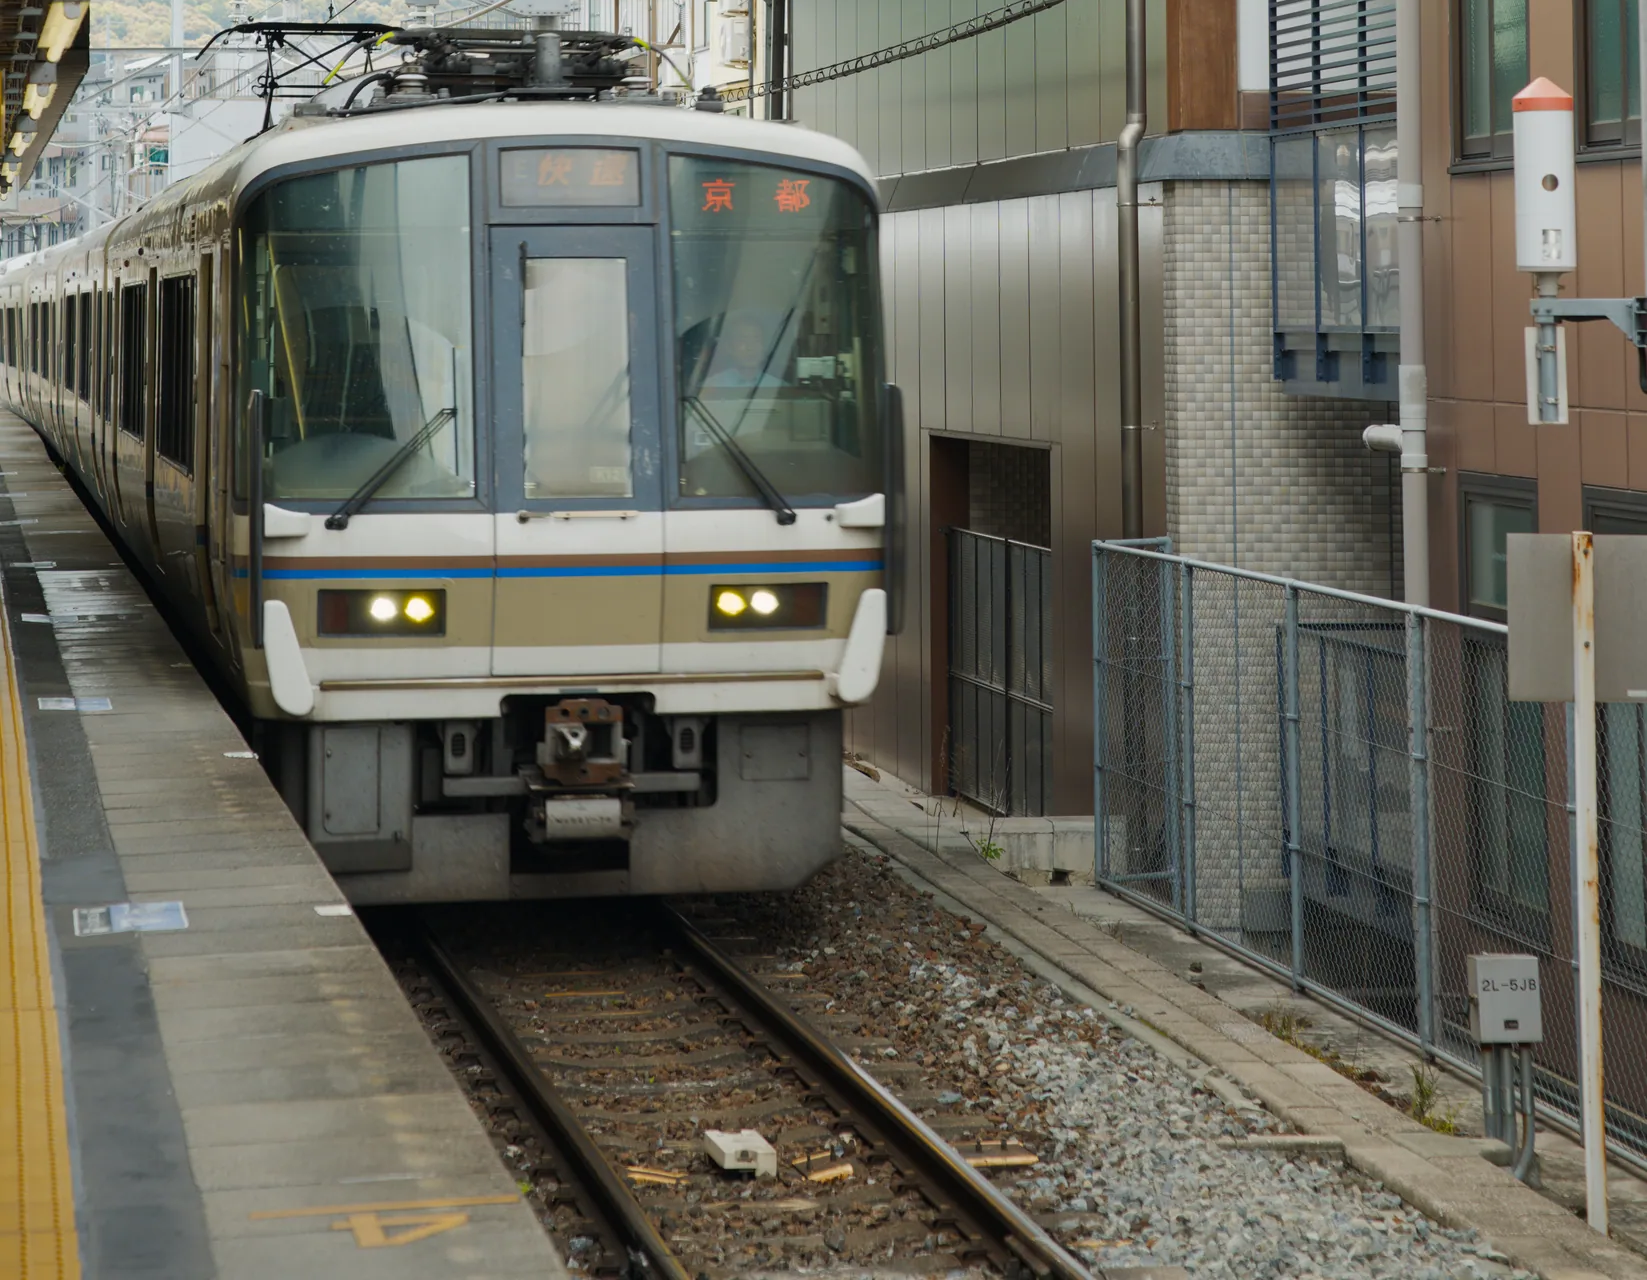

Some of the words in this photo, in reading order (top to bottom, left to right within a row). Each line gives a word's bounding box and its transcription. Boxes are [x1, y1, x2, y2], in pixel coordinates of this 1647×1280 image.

[537, 154, 629, 186] 快速
[702, 178, 811, 212] 京都
[1481, 978, 1537, 992] 2L-5JB
